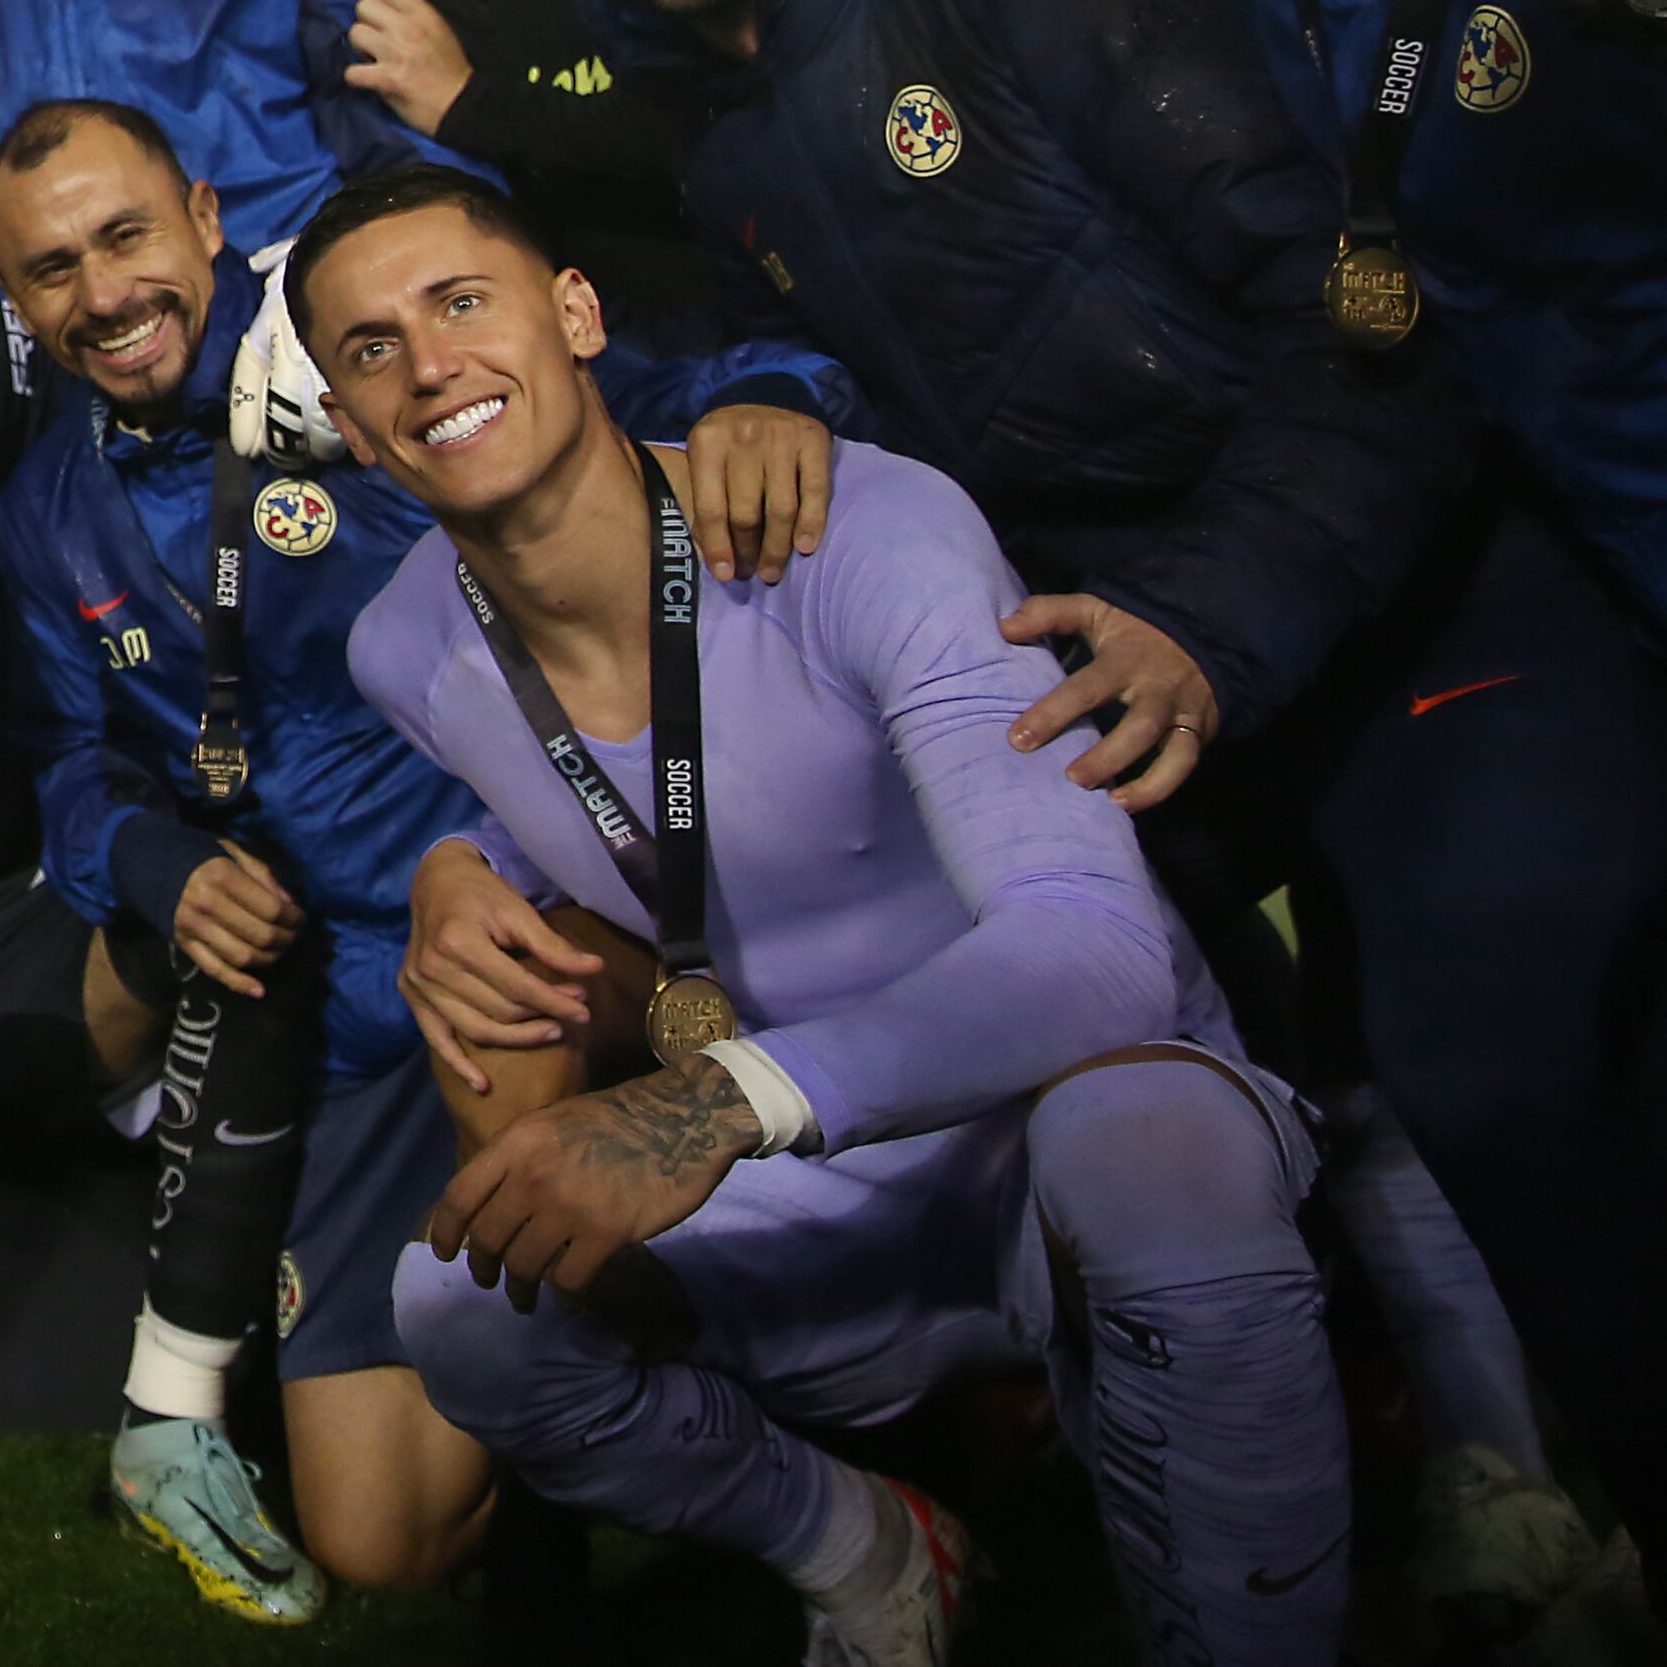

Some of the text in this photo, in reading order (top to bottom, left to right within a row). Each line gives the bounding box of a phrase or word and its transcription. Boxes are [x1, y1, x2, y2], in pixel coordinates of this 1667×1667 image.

[1378, 38, 1424, 115] SOCCER
[216, 547, 241, 608] SOCCER
[660, 517, 693, 624] MATCH
[546, 734, 631, 840] MATCH
[666, 759, 693, 831] SOCCER
